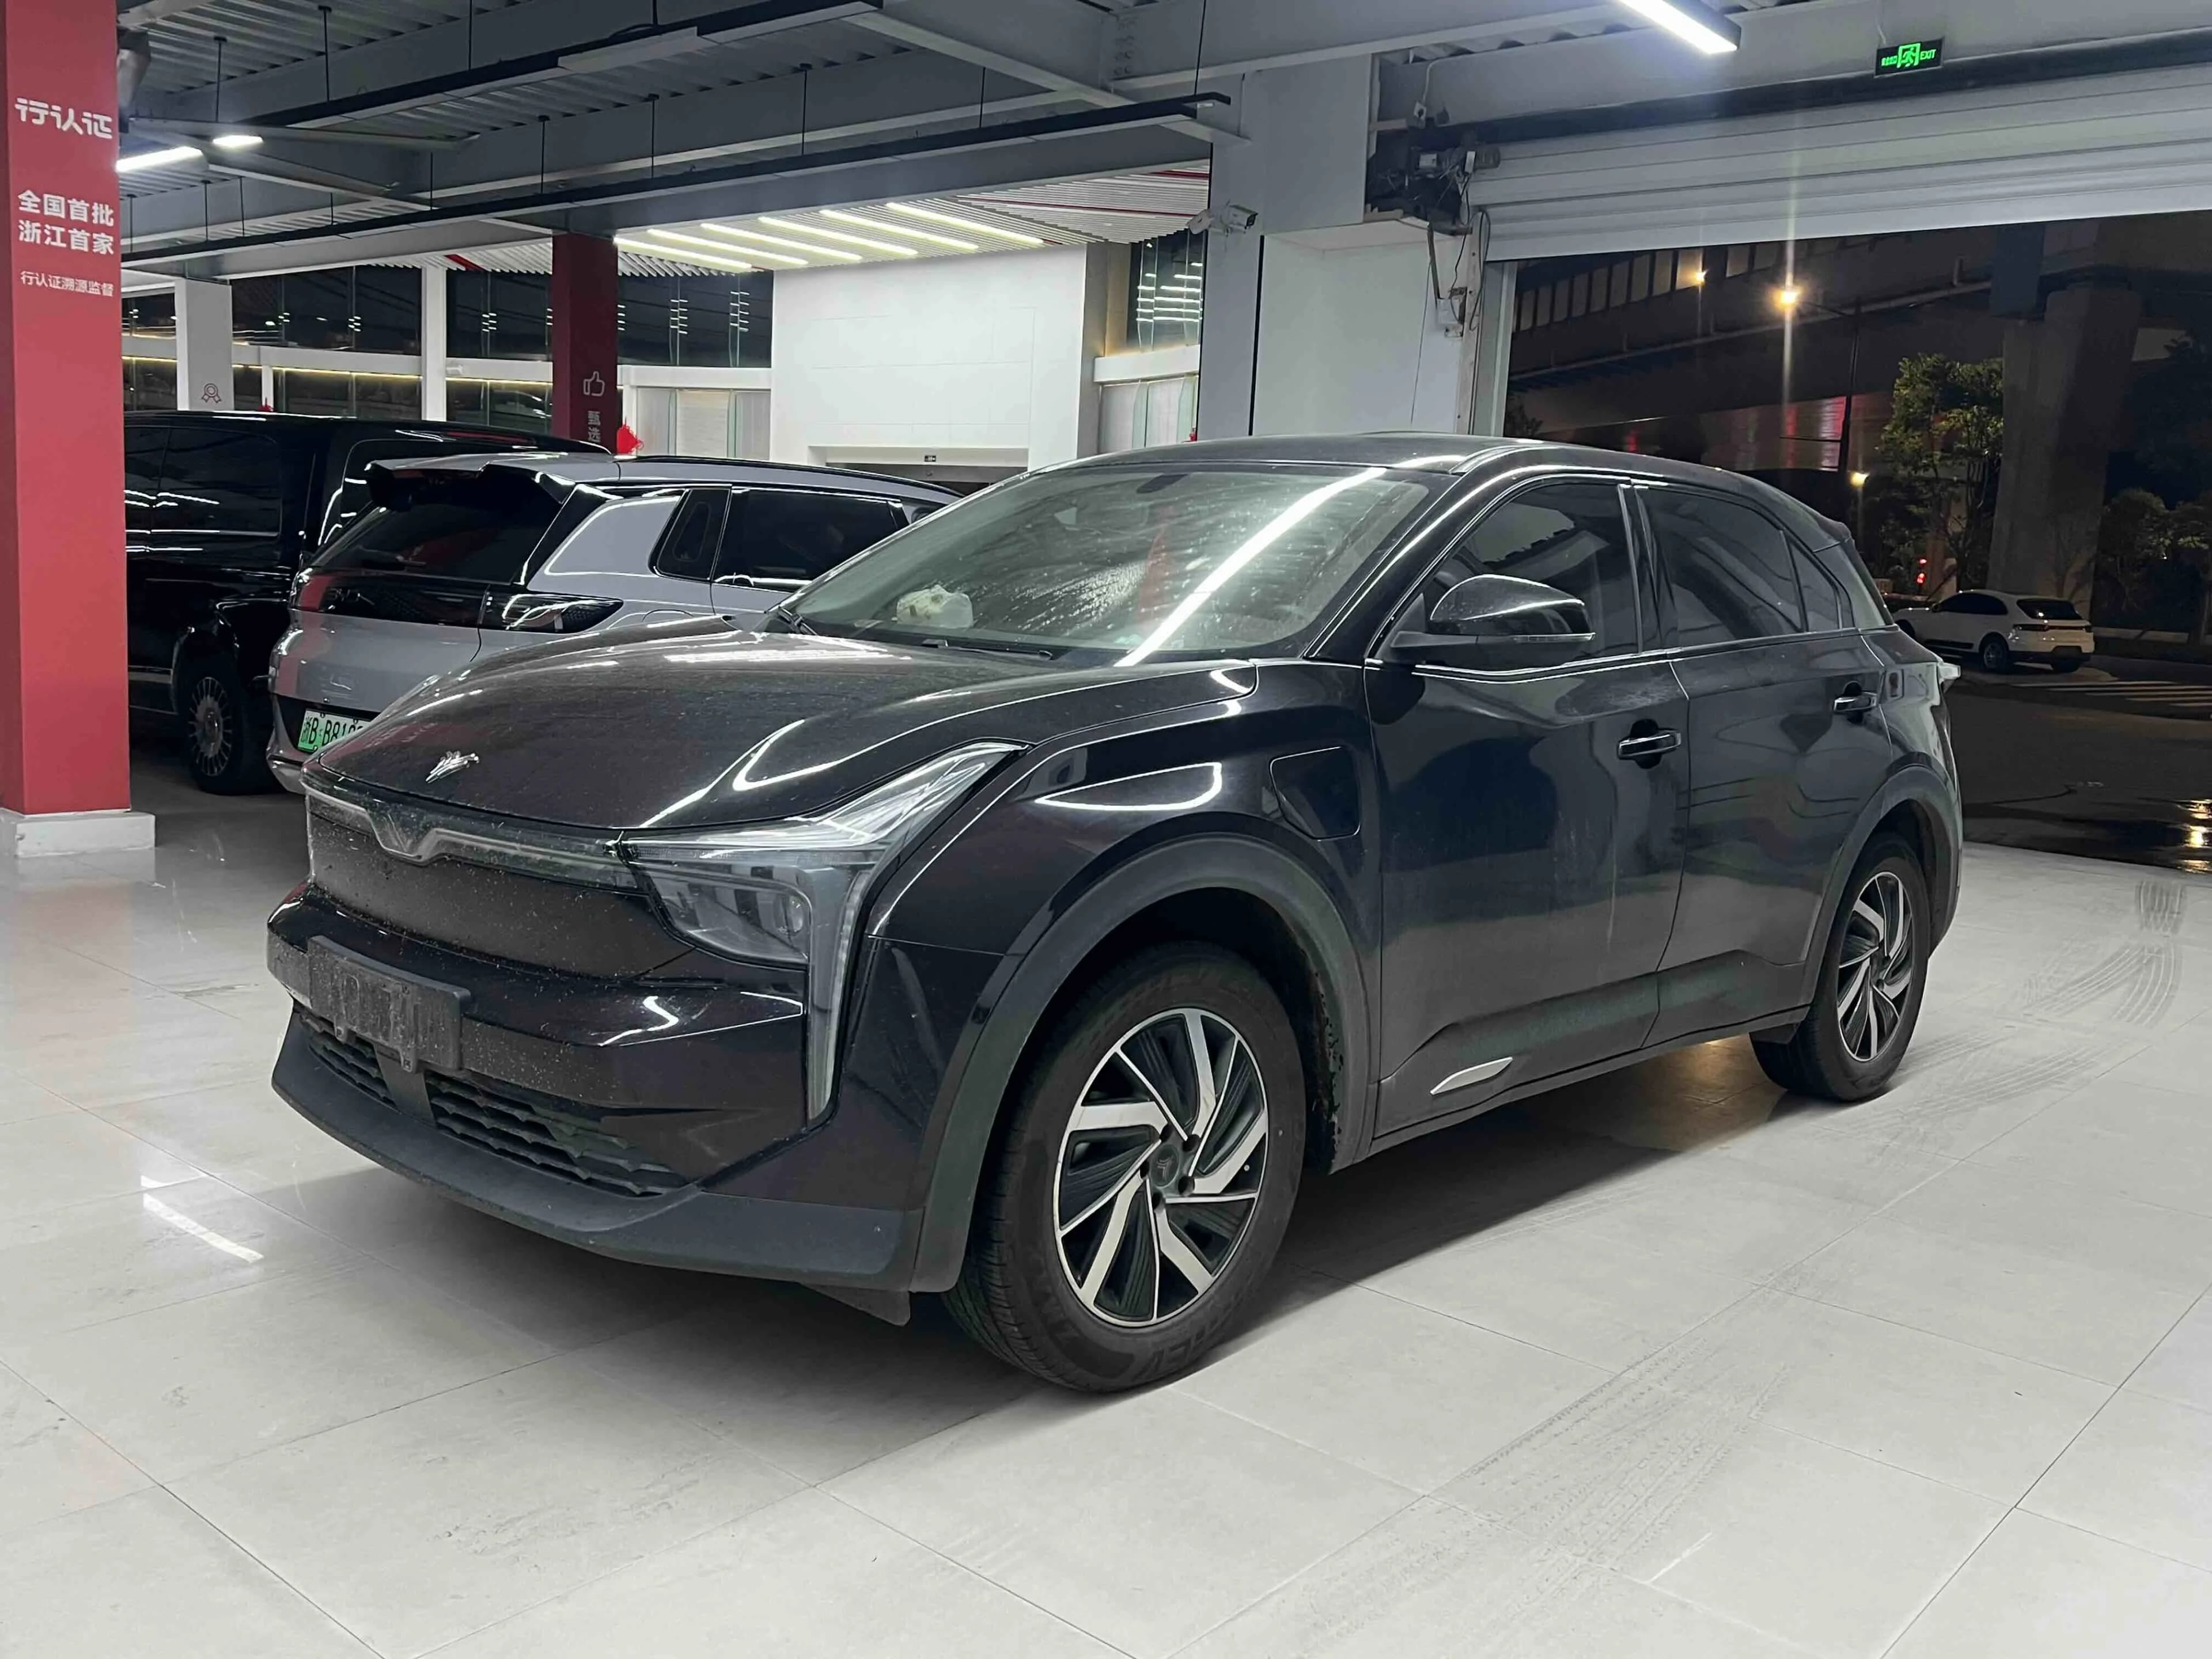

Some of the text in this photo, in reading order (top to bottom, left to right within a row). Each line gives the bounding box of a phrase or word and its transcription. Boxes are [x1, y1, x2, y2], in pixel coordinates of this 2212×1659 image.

[1921, 50, 1936, 60] EXIT
[14, 97, 113, 139] 行认证
[18, 189, 114, 227] 全国首批
[18, 219, 114, 255] 浙江首家
[20, 270, 114, 297] 行认证溯源监督
